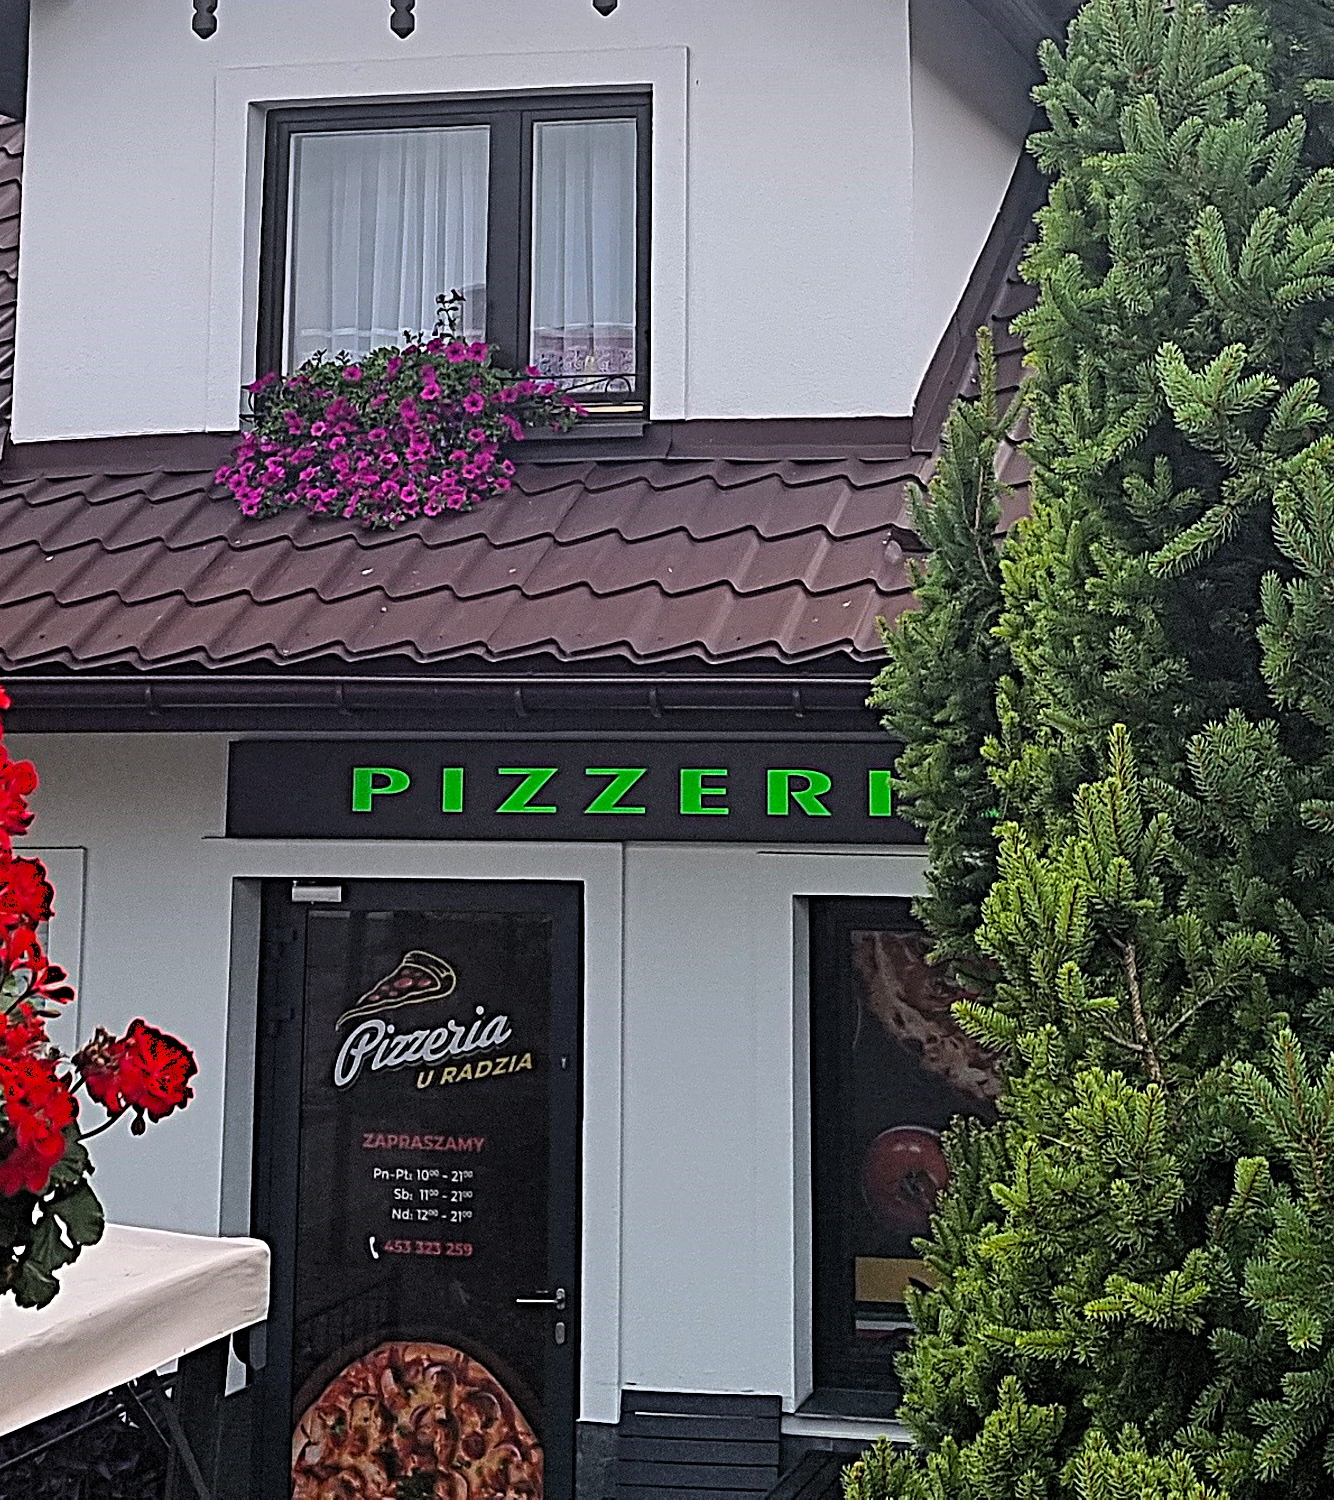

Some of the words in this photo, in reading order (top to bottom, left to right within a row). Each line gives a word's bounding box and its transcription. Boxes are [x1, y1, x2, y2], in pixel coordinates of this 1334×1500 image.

[351, 766, 1001, 817] PIZZERI
[334, 1005, 513, 1087] Pizzeria
[416, 1070, 435, 1089] U
[440, 1052, 533, 1085] RADZIA
[362, 1133, 485, 1152] ZAPRASZAMY
[445, 1242, 473, 1257] 259
